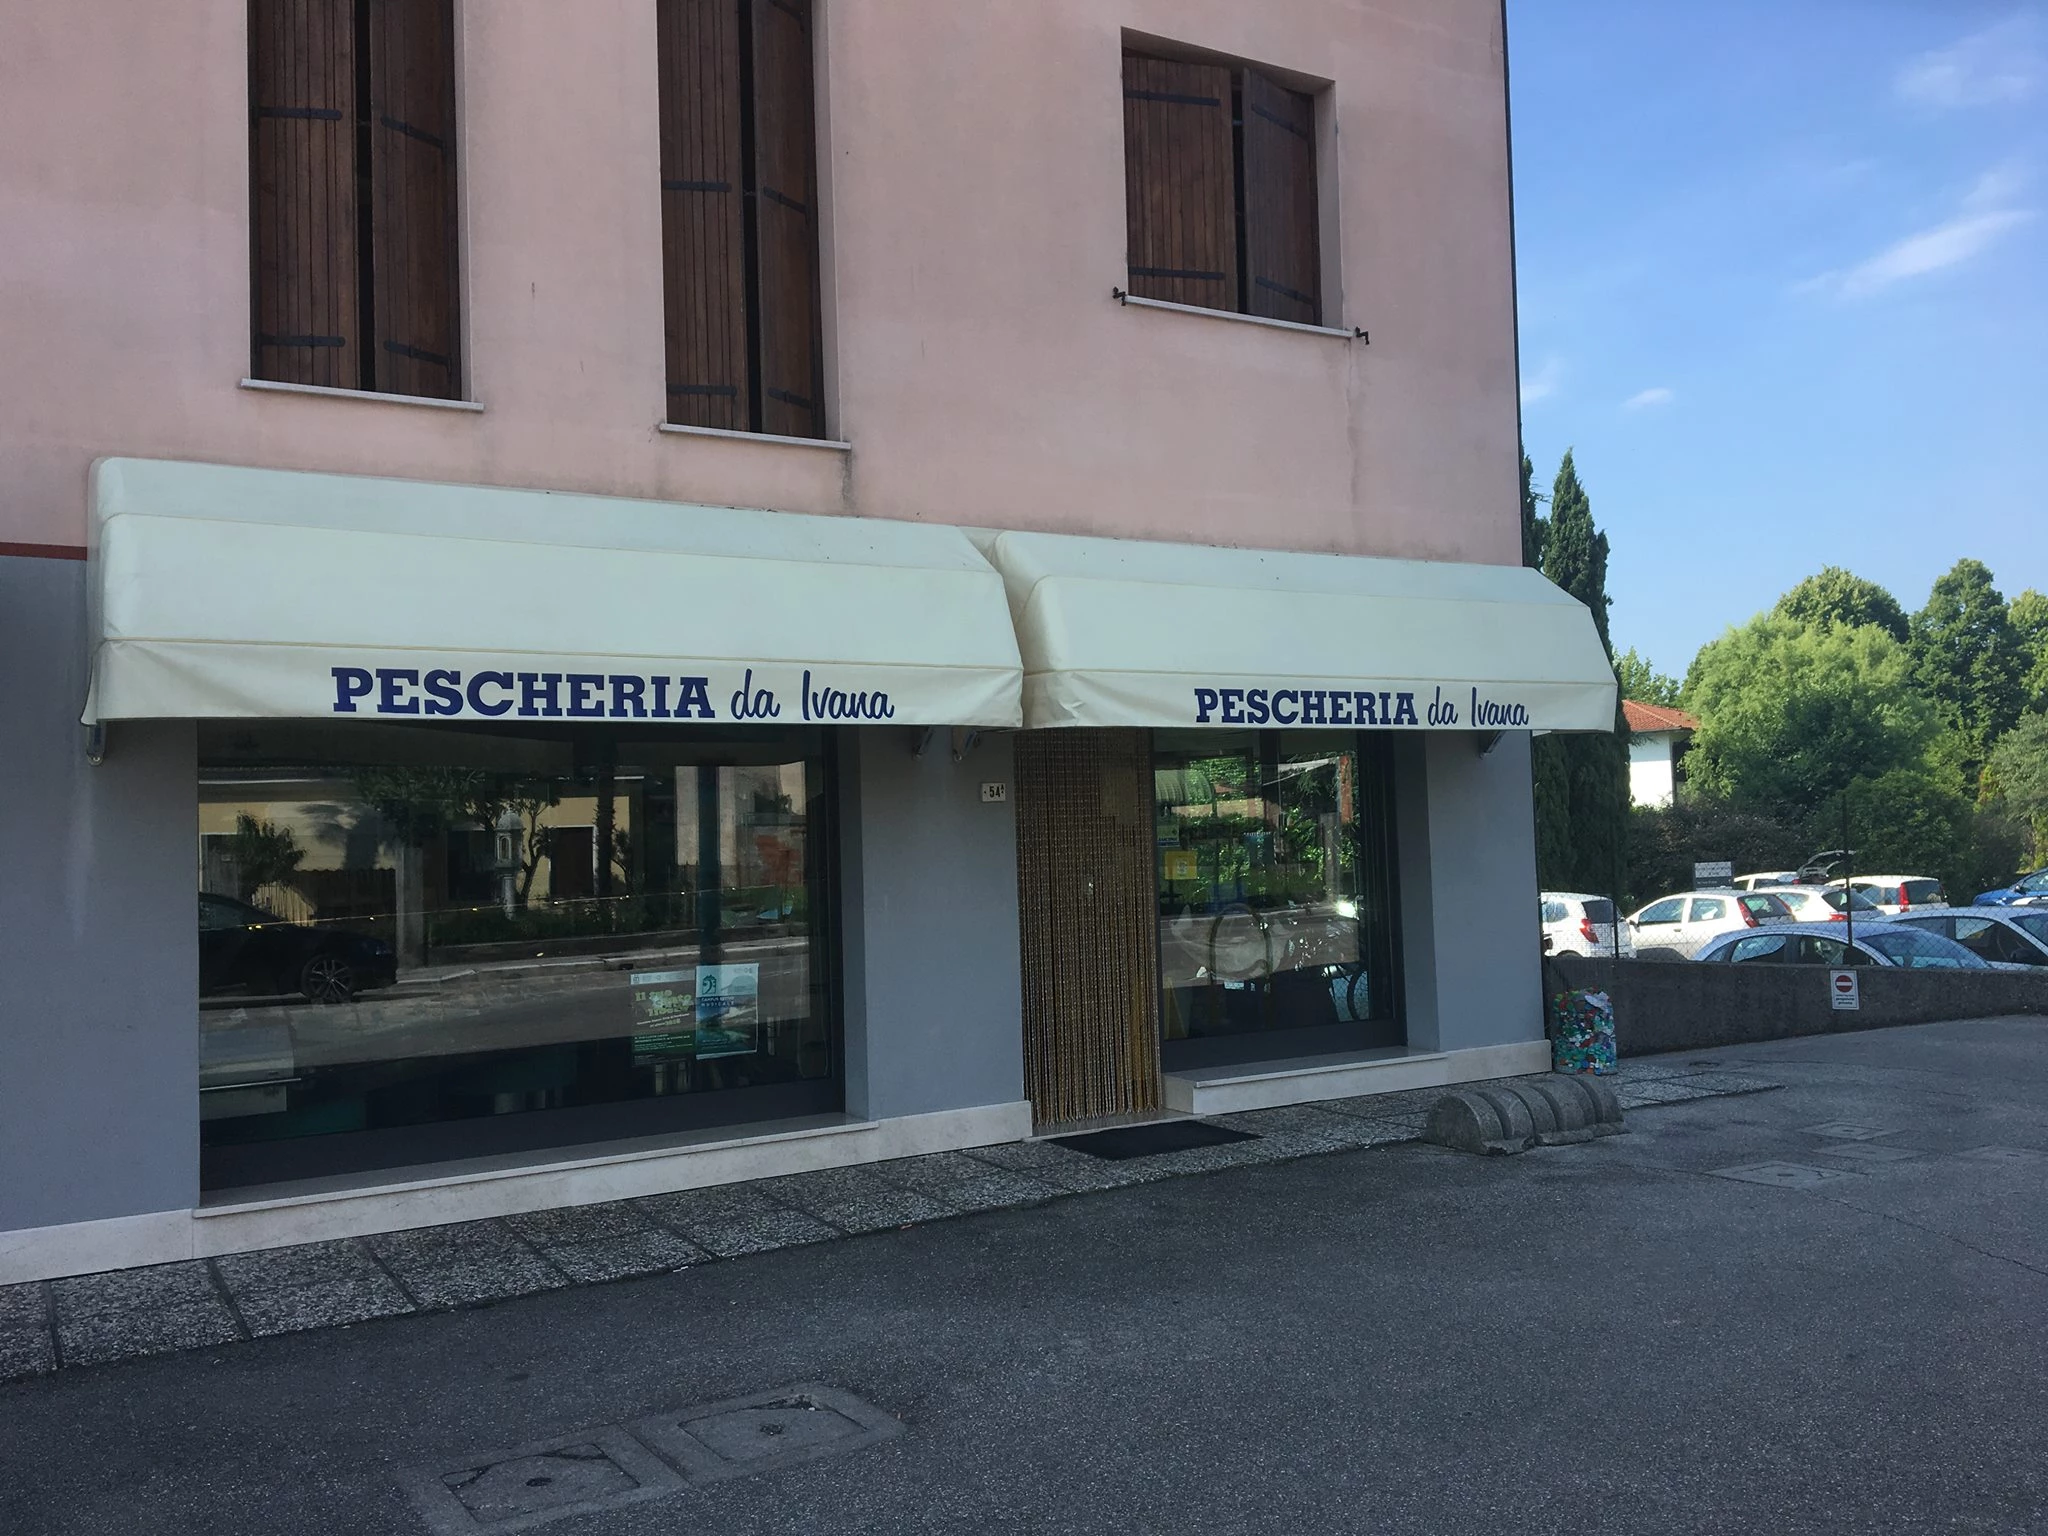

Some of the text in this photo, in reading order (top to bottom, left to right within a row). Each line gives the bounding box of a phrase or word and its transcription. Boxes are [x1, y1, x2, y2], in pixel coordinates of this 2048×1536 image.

[332, 667, 896, 722] PESCHERIA da Ivana
[1194, 686, 1530, 727] PESCHERIA da Ivana
